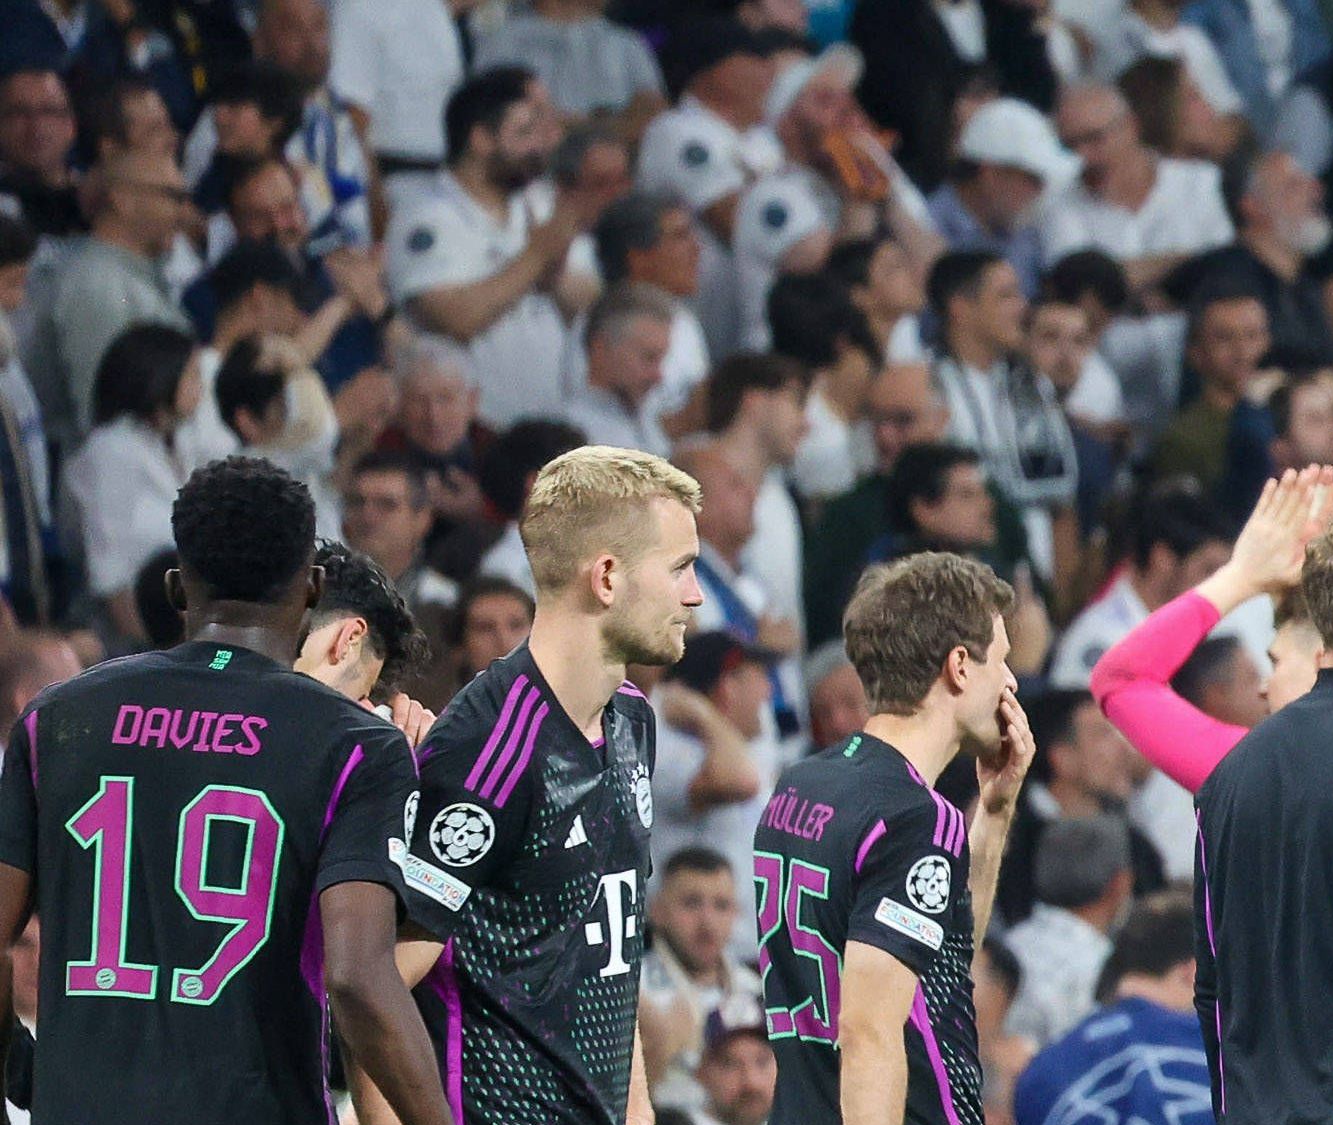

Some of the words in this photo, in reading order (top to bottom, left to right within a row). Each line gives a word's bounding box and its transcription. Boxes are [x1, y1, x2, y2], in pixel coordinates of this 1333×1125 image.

[111, 705, 268, 755] DAVIES
[758, 786, 835, 843] MÜLLER
[66, 776, 285, 1005] 19
[753, 850, 844, 1051] 25
